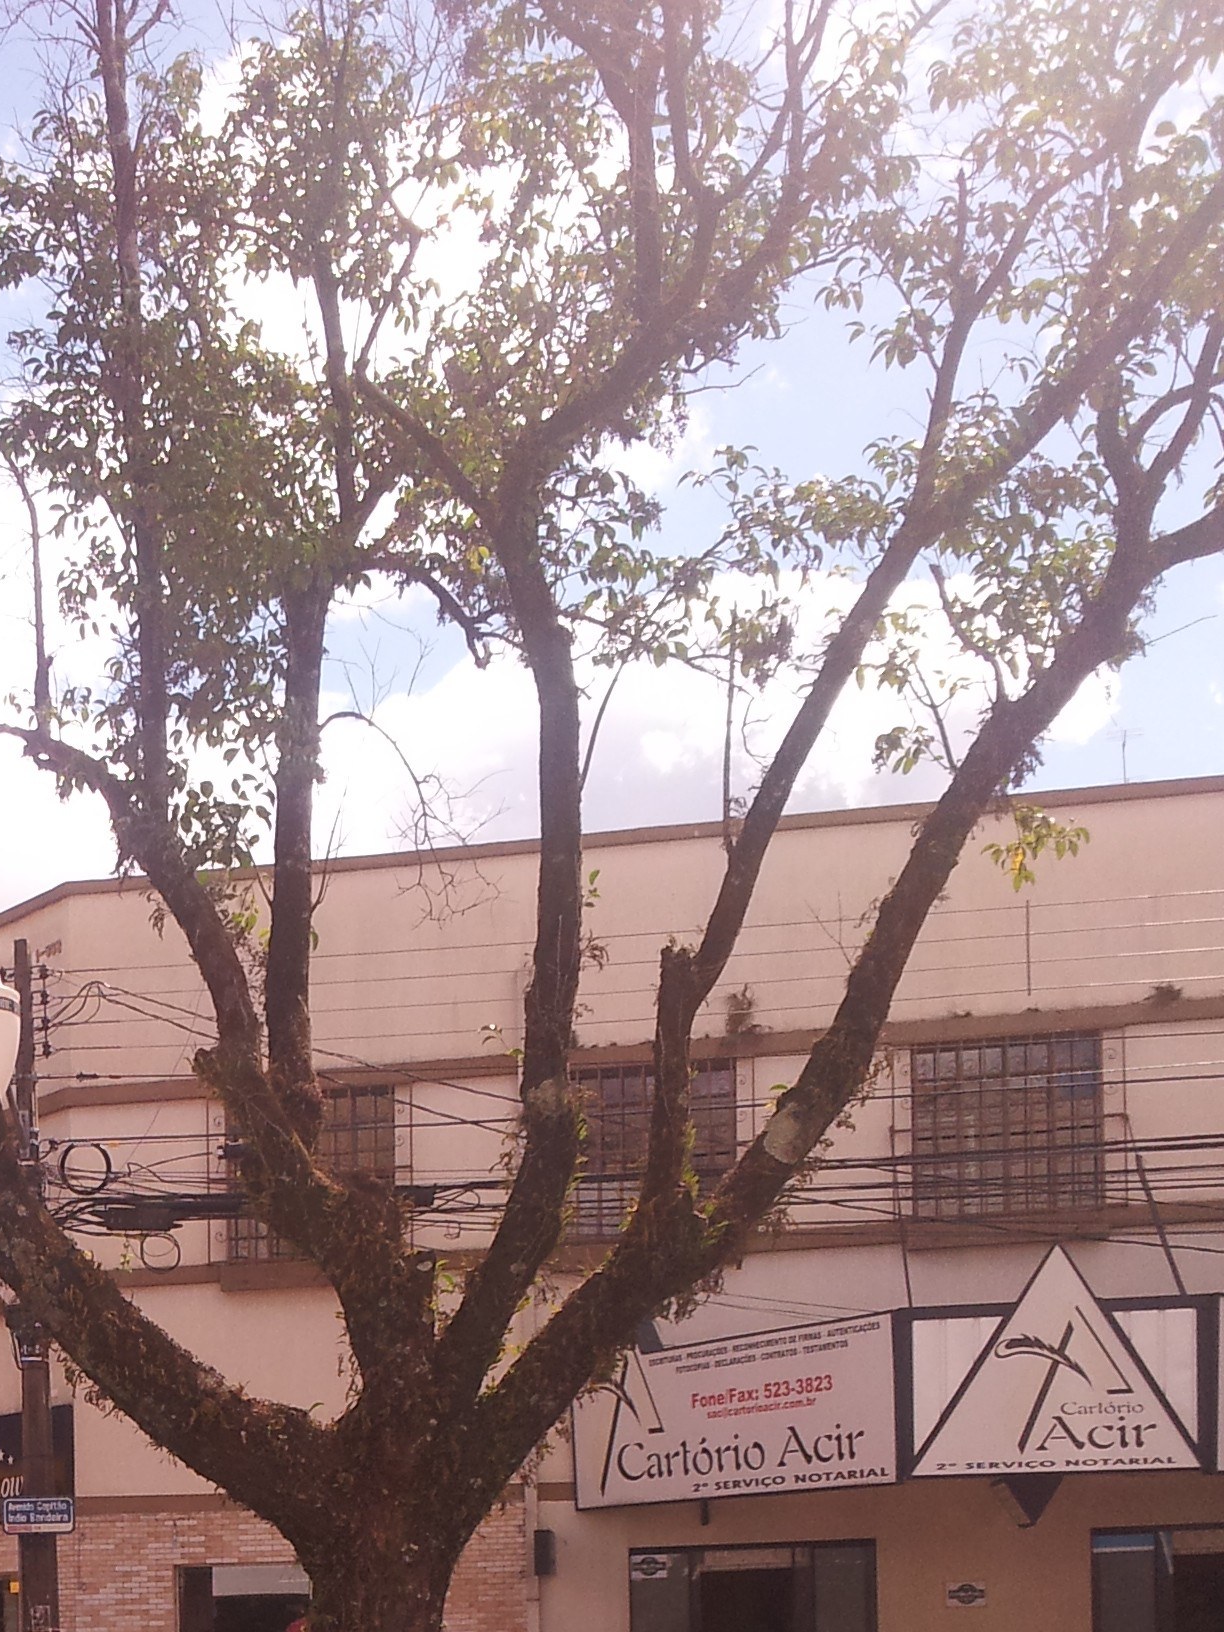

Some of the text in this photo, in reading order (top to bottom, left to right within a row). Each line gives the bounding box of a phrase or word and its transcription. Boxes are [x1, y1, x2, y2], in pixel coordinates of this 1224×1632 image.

[763, 1374, 834, 1399] 523-3823
[1059, 1401, 1145, 1416] Cartório
[1035, 1415, 1157, 1451] Acir
[617, 1423, 865, 1482] Cartório Acir
[965, 1459, 1056, 1470] SERVIÇO
[1065, 1456, 1177, 1467] NOTARIAL
[714, 1474, 786, 1491] SERVIÇO
[793, 1466, 890, 1484] NOTARIAL
